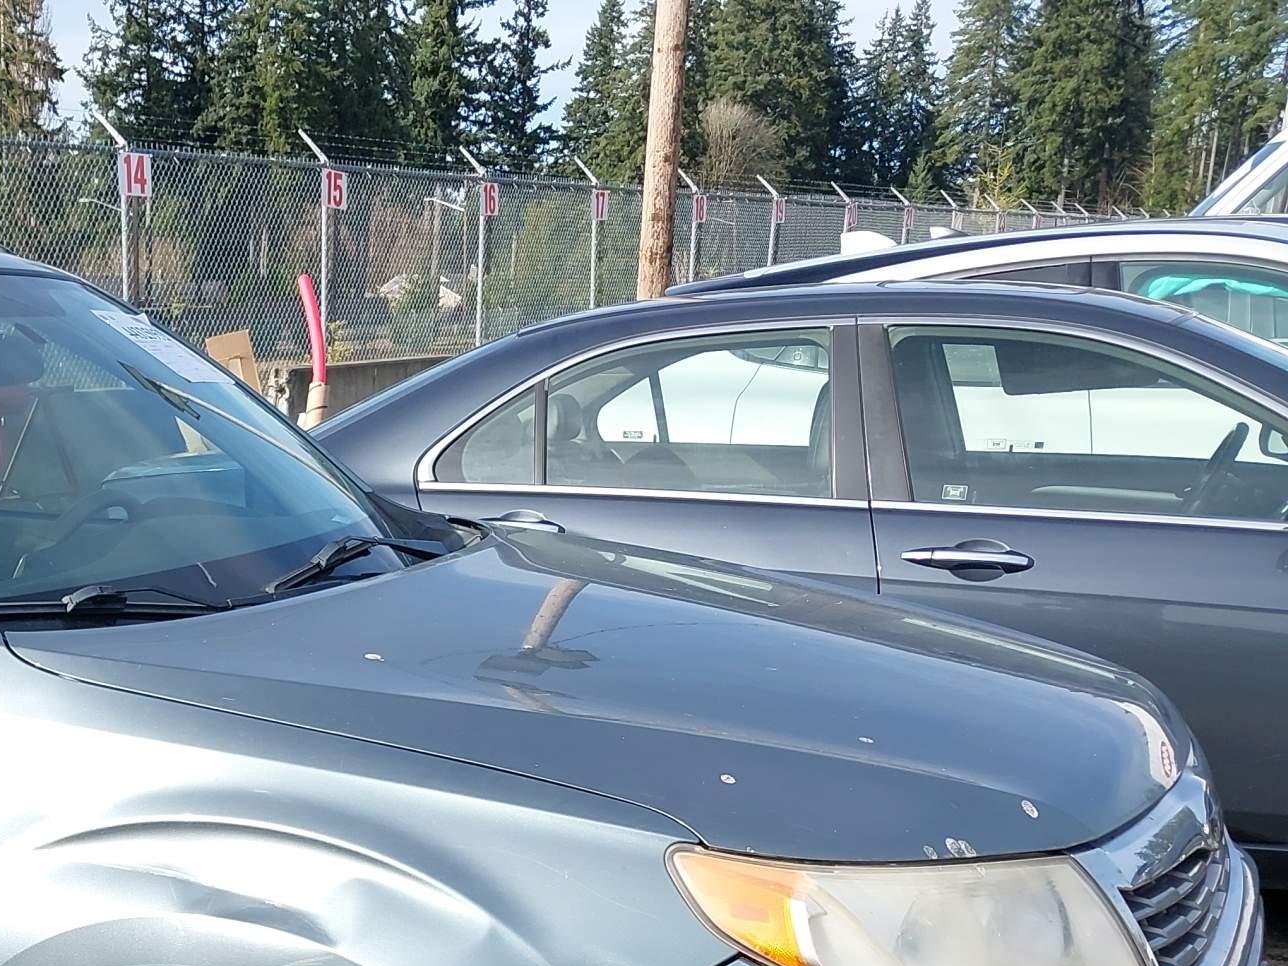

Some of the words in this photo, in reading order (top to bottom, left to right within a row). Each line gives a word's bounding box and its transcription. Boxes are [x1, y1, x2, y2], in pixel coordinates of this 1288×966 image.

[123, 154, 147, 195] 14
[326, 171, 343, 208] 15
[483, 184, 496, 214] 16
[595, 191, 606, 219] 17
[696, 196, 705, 221] 18
